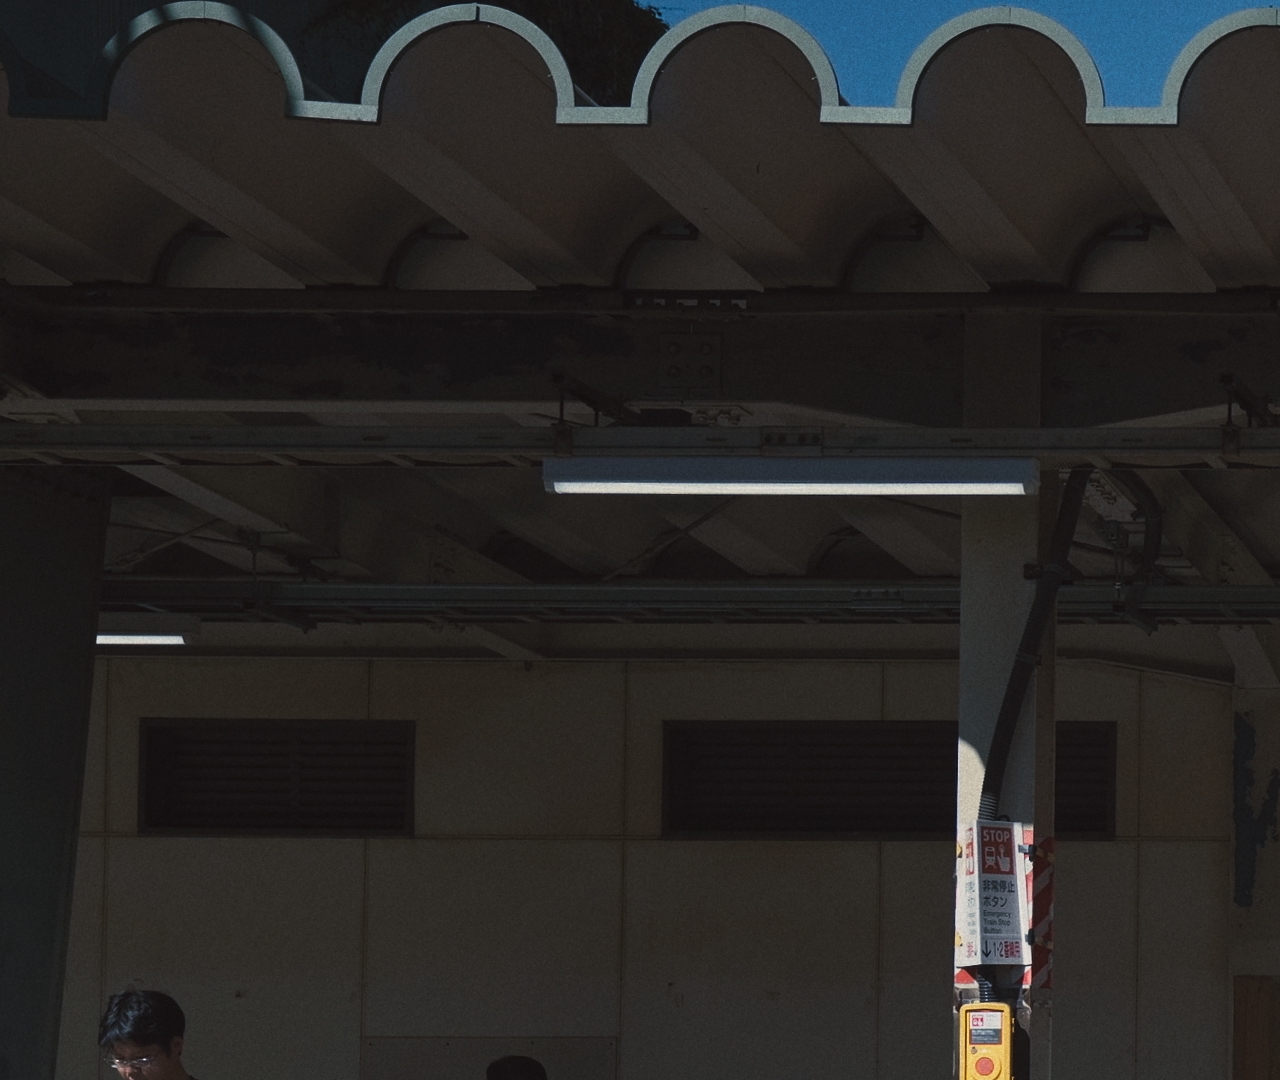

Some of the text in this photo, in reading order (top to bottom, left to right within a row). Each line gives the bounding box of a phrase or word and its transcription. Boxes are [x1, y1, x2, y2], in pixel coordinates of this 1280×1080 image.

[983, 830, 1010, 842] STOP
[983, 881, 1015, 893] 非常停止
[983, 896, 1008, 908] ボタン
[983, 910, 1011, 918] Emergency
[998, 919, 1011, 927] Stop
